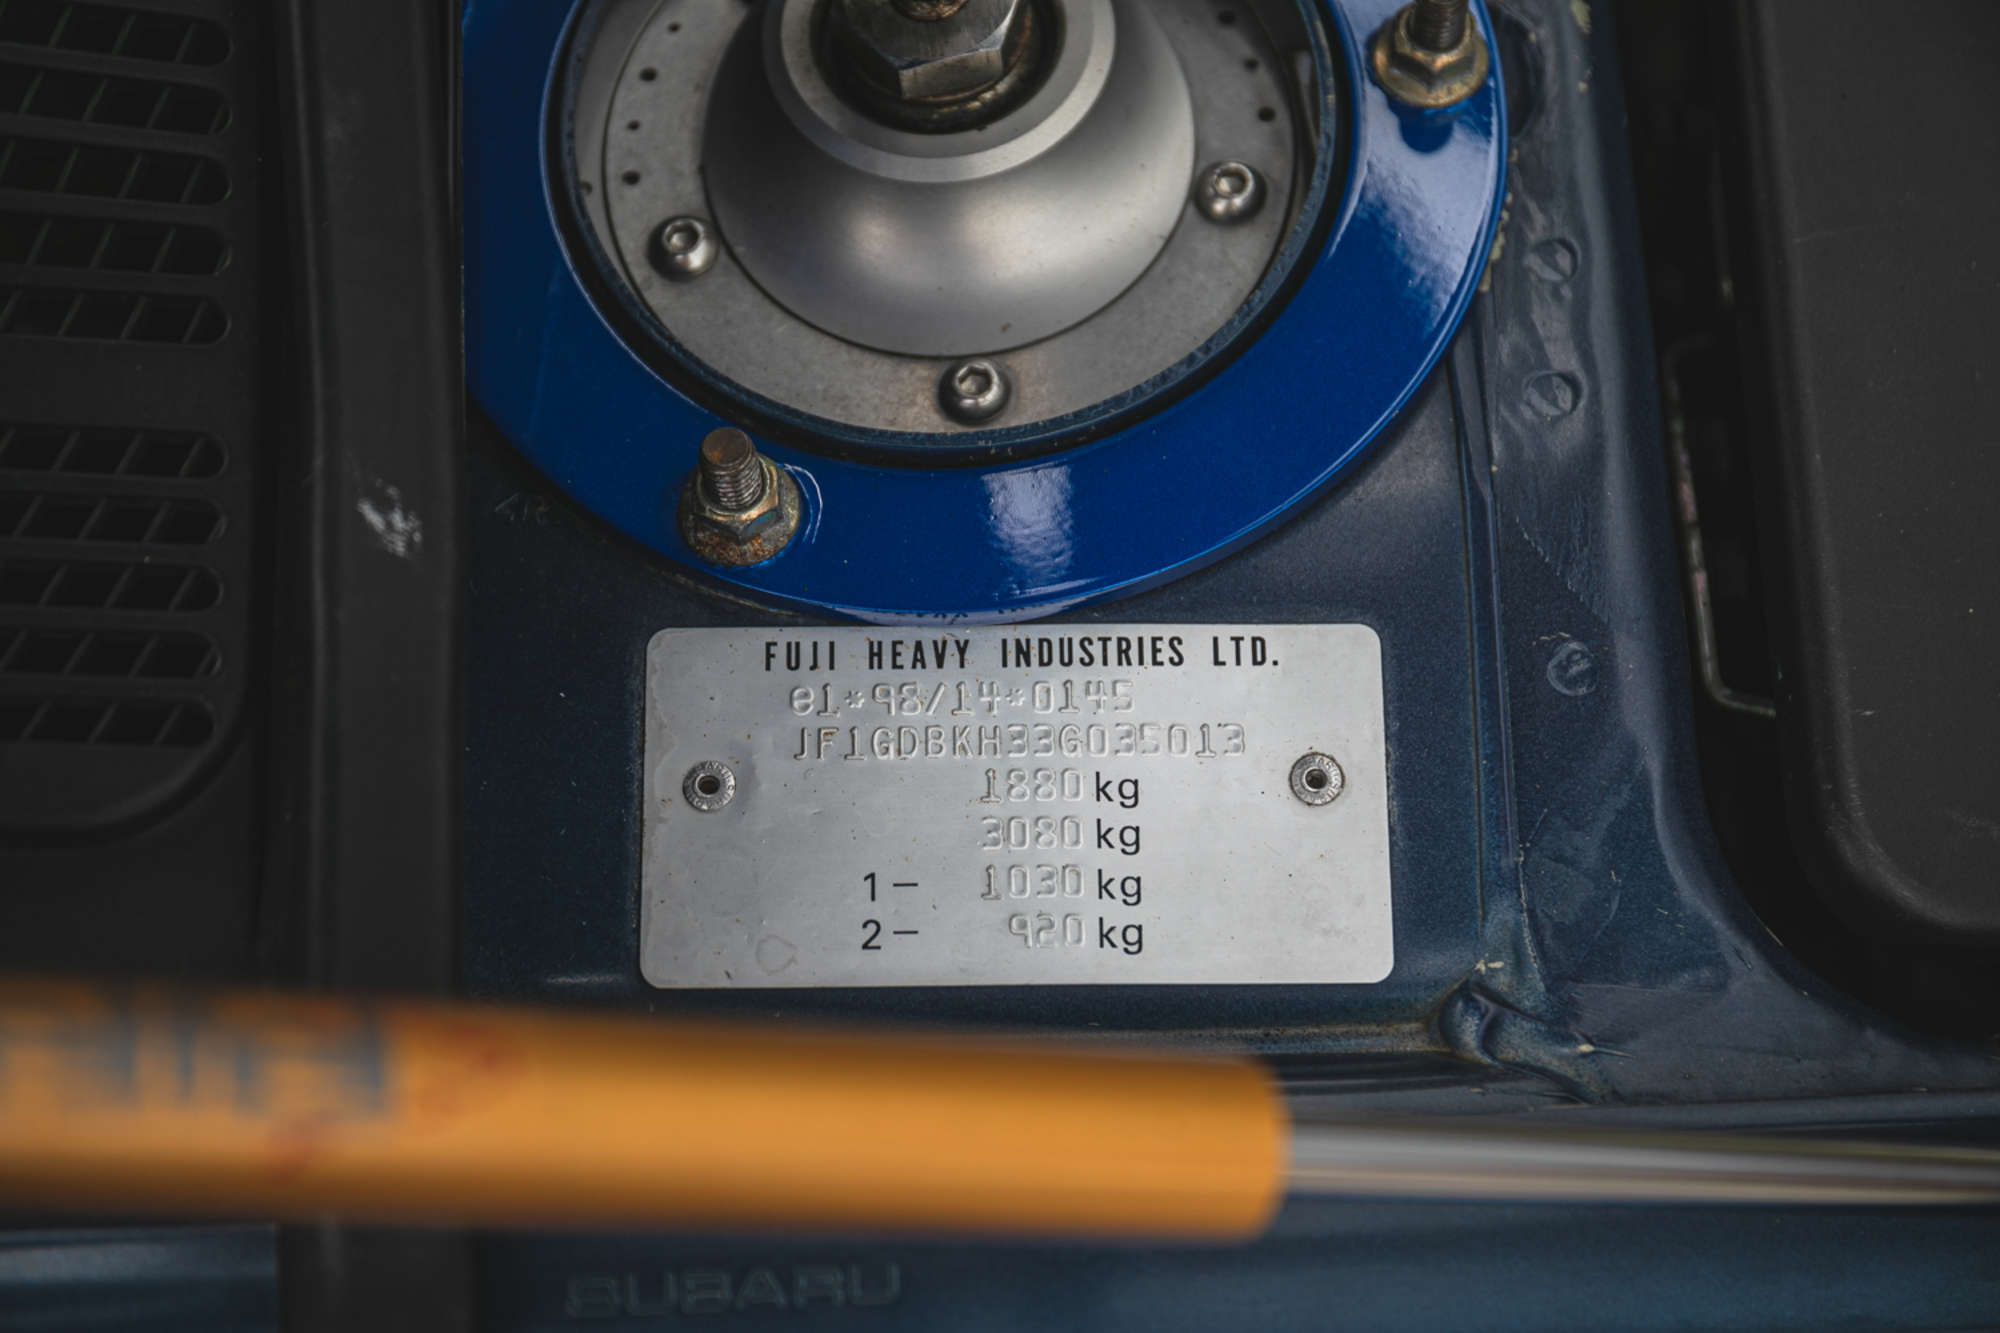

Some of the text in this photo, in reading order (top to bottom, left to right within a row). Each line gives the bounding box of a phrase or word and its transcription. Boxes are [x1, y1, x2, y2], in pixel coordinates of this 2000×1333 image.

[764, 635, 1280, 672] FUJI HEAVY INDUSTRIES LTD.
[793, 722, 1247, 761] JF1GDBKH33G035013
[979, 767, 1140, 809] 1880 kg
[978, 815, 1141, 856] 3080 kg
[980, 863, 1085, 900] 1030
[1097, 868, 1142, 907] kg
[1008, 911, 1087, 949] 920
[1098, 916, 1144, 956] kg
[565, 1263, 901, 1318] SUBARU
